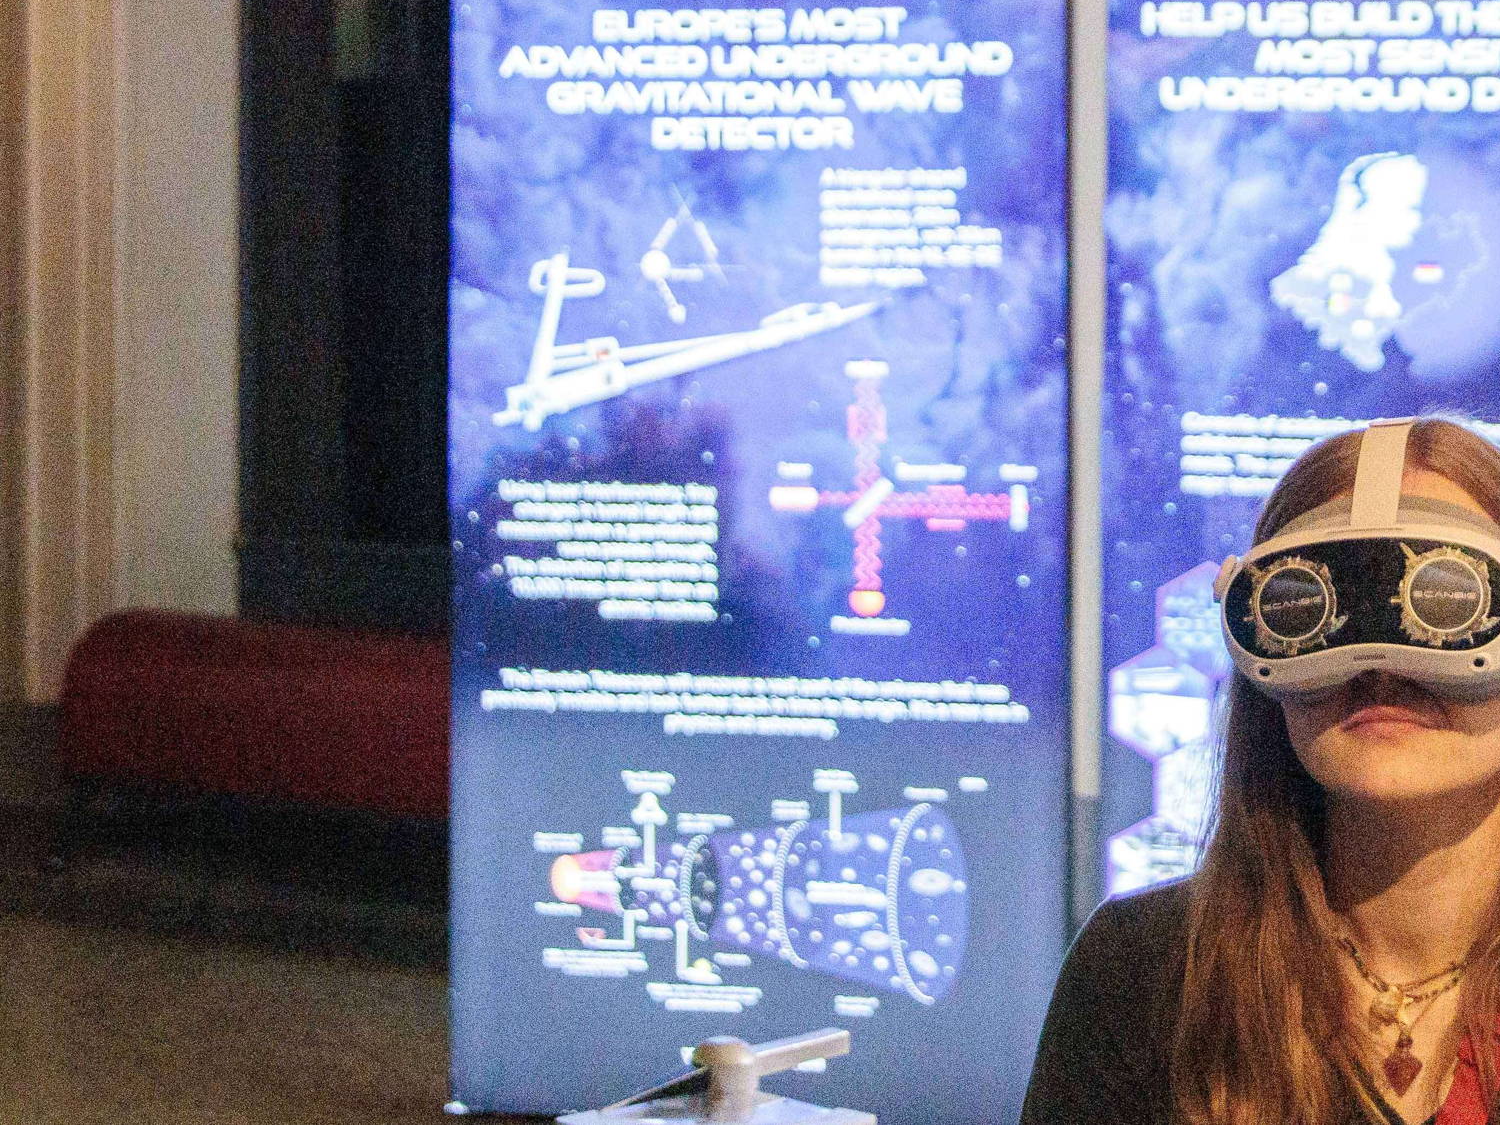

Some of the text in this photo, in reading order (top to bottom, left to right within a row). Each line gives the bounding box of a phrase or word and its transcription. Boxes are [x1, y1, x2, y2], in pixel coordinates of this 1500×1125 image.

[592, 6, 907, 43] EUROPE'S MOST
[1140, 1, 1246, 37] HELP
[1246, 1, 1309, 36] US
[1310, 0, 1433, 36] BUILD
[498, 41, 1013, 78] ADVANCED UNDERGROUND
[1254, 40, 1376, 74] MOST
[546, 78, 963, 114] GRAVITATIONAL WAVE
[1158, 76, 1470, 113] UNDERGROUND
[651, 116, 854, 150] DETECTOR
